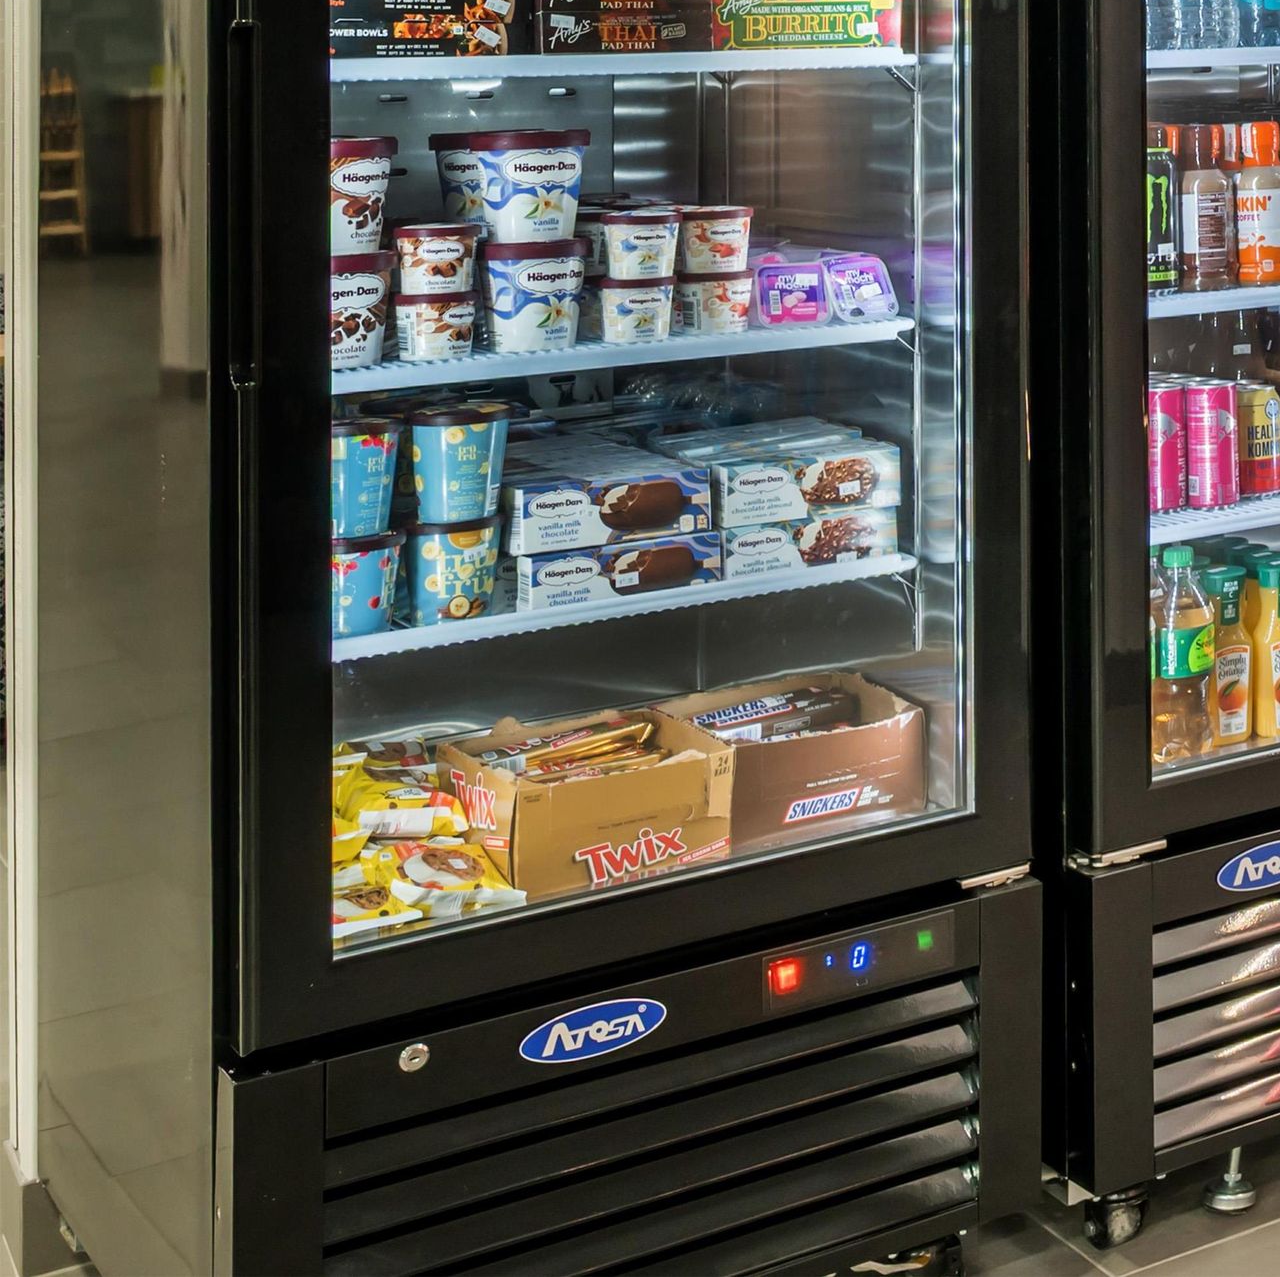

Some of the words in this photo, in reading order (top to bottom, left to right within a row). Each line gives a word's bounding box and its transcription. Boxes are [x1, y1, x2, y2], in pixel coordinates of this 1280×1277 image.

[600, 1, 621, 9] PAD
[624, 0, 654, 9] THAI
[743, 12, 867, 42] BURRITO
[772, 34, 811, 42] CHEDDAR
[813, 33, 844, 41] CHEESE
[514, 162, 576, 173] Häagen-Dazs
[533, 217, 559, 226] vanilla
[788, 789, 856, 819] SNICKERS
[574, 827, 687, 883] Twix
[852, 945, 865, 969] 0
